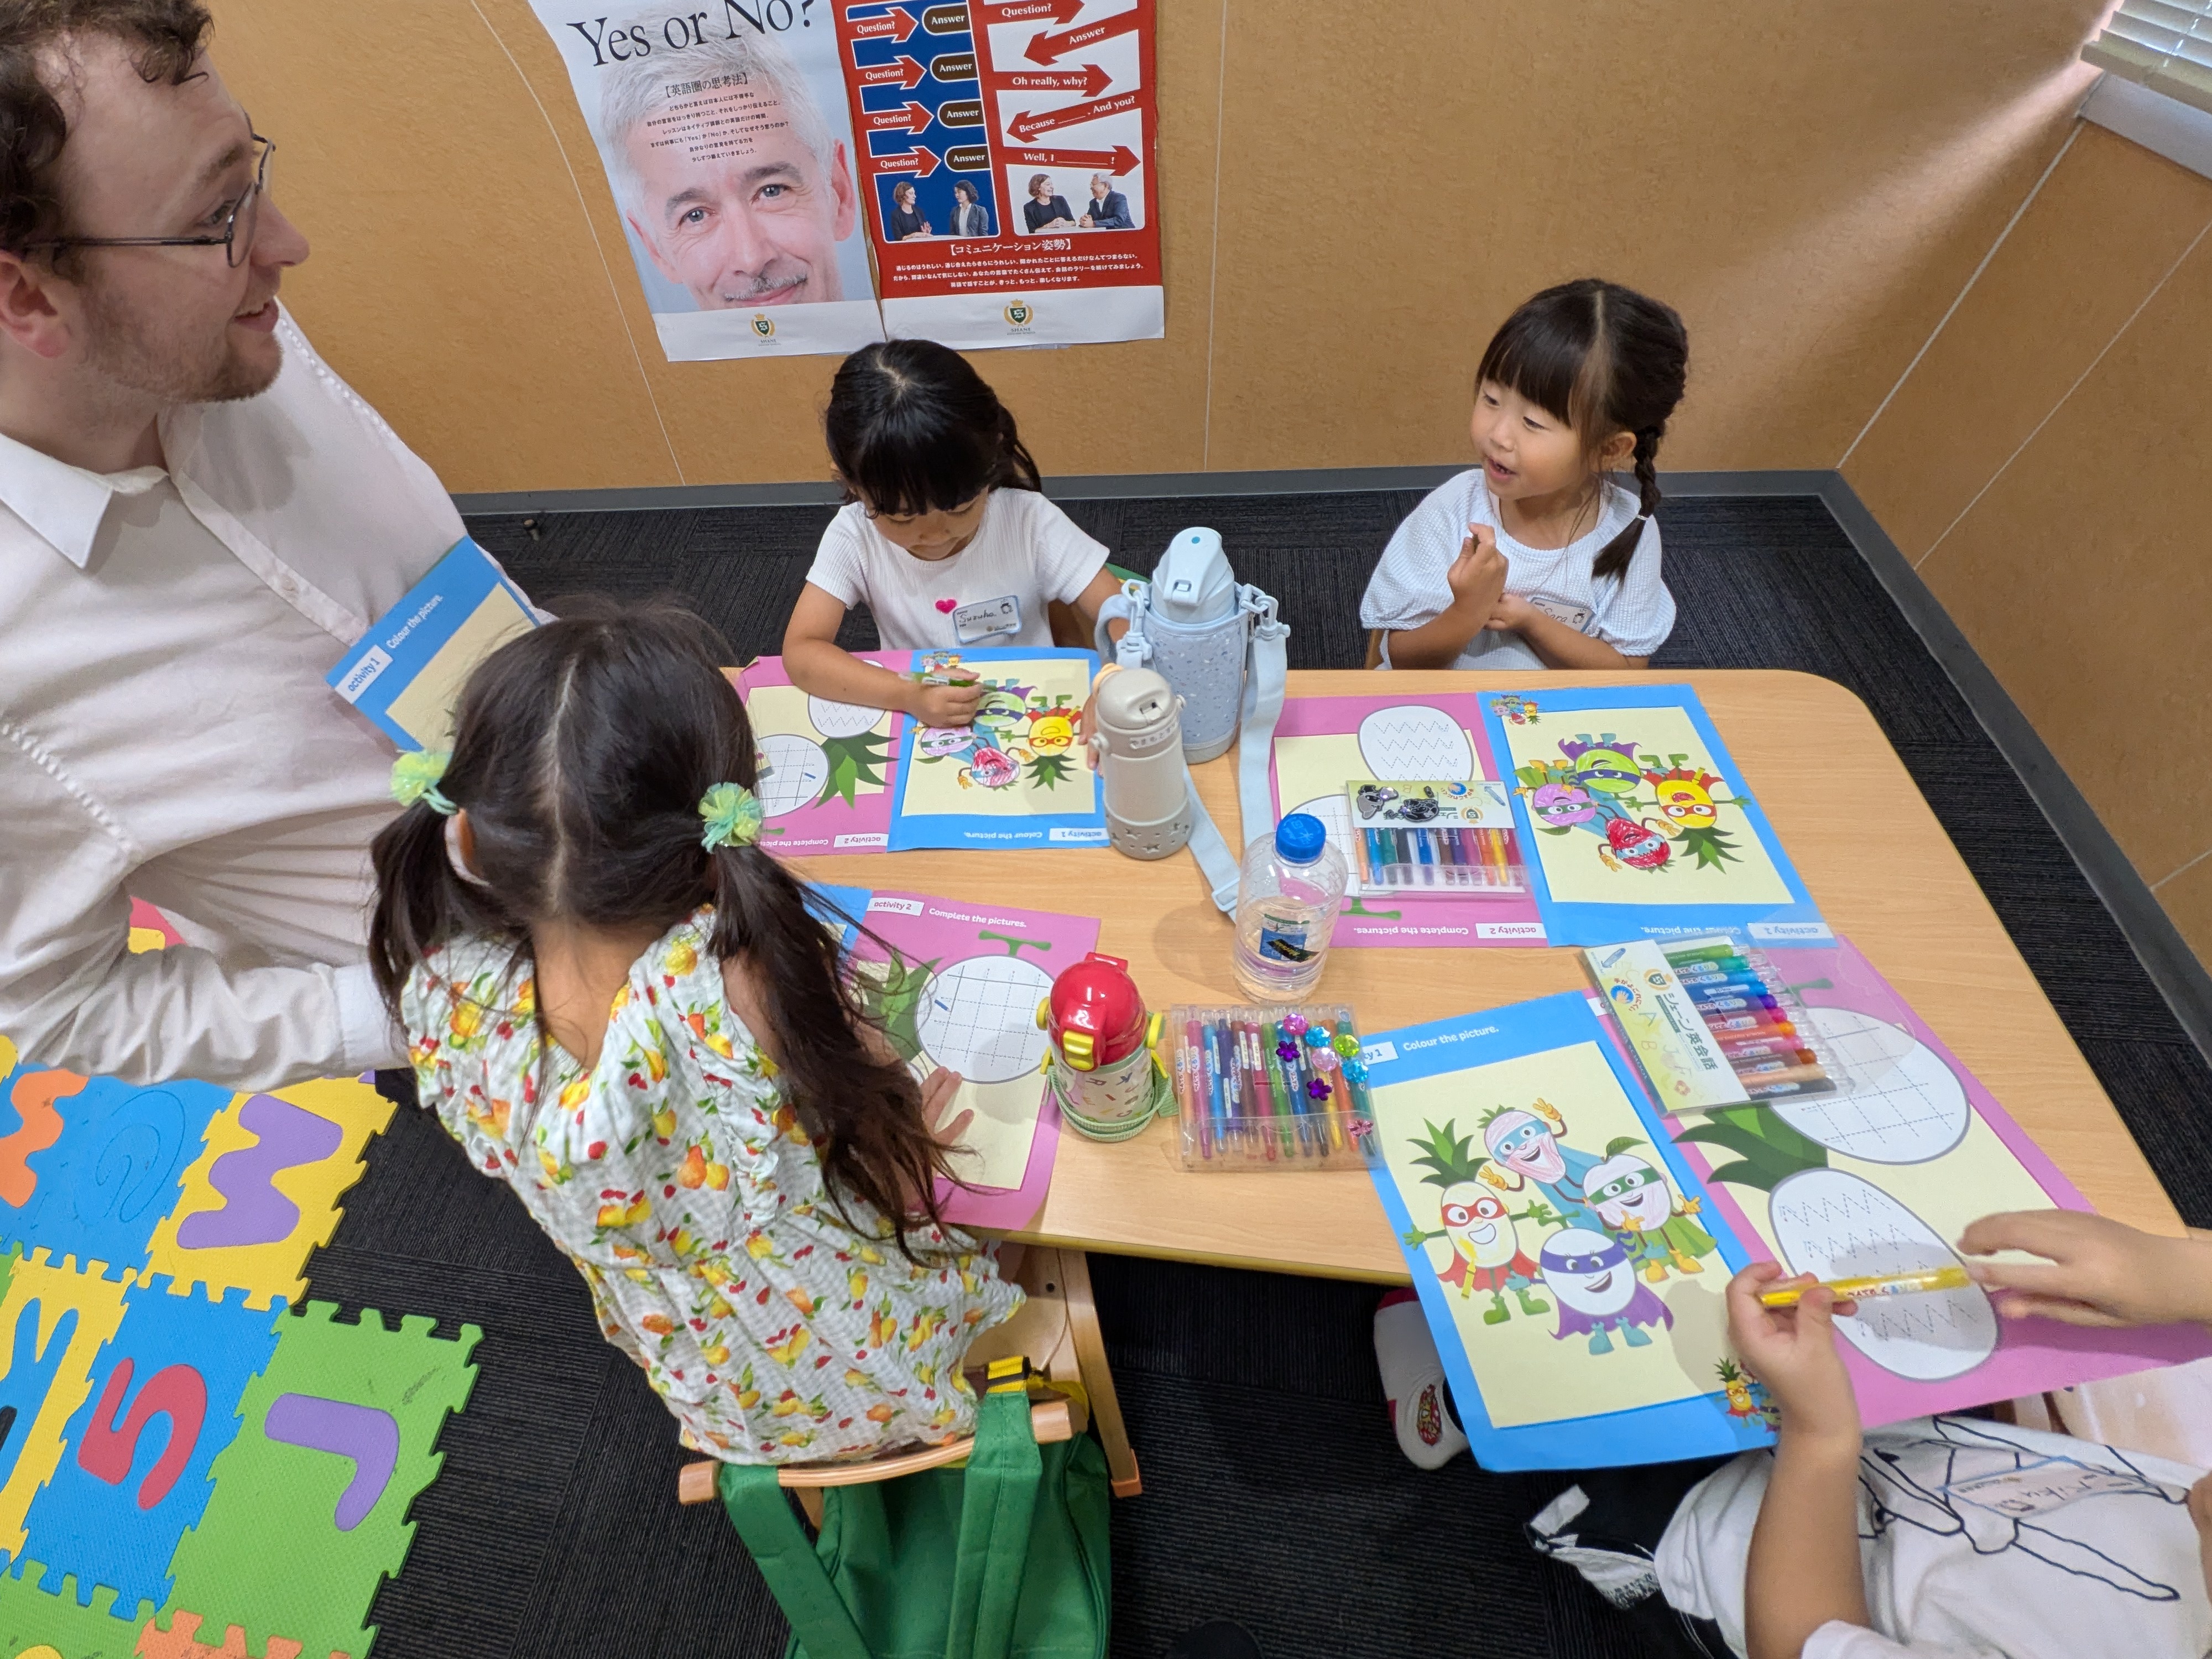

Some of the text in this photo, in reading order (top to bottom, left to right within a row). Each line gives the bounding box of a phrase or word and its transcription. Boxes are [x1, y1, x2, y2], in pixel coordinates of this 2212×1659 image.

[1001, 3, 1052, 18] Question?
[931, 14, 965, 25] Answer
[566, 0, 815, 66] Yes or No?
[857, 21, 895, 35] Question?
[1069, 27, 1105, 45] Answer
[940, 63, 972, 72] Answer
[865, 69, 904, 81] Question?
[666, 72, 748, 98] 【英語圏の思考法】
[1012, 77, 1087, 87] Oh really, why?
[873, 114, 911, 125] Question?
[947, 110, 979, 118] Answer
[1019, 96, 1135, 133] Because And you?
[953, 154, 985, 163] Answer
[1024, 153, 1047, 162] Well,
[880, 158, 919, 169] Question?
[950, 238, 1072, 256] 【コミュニケーション姿勢】
[385, 626, 411, 649] Colour
[407, 615, 421, 628] the
[348, 662, 377, 691] activity
[874, 901, 905, 910] activity
[929, 908, 1027, 928] Complete the pictures.
[1353, 927, 1469, 935] Complete the pictures.
[1641, 926, 1681, 935] picture.
[1774, 926, 1818, 935] activity
[1663, 993, 1718, 1071] シェーン英会話
[1403, 1026, 1499, 1051] Colour the picture.
[1377, 1048, 1383, 1057] 1
